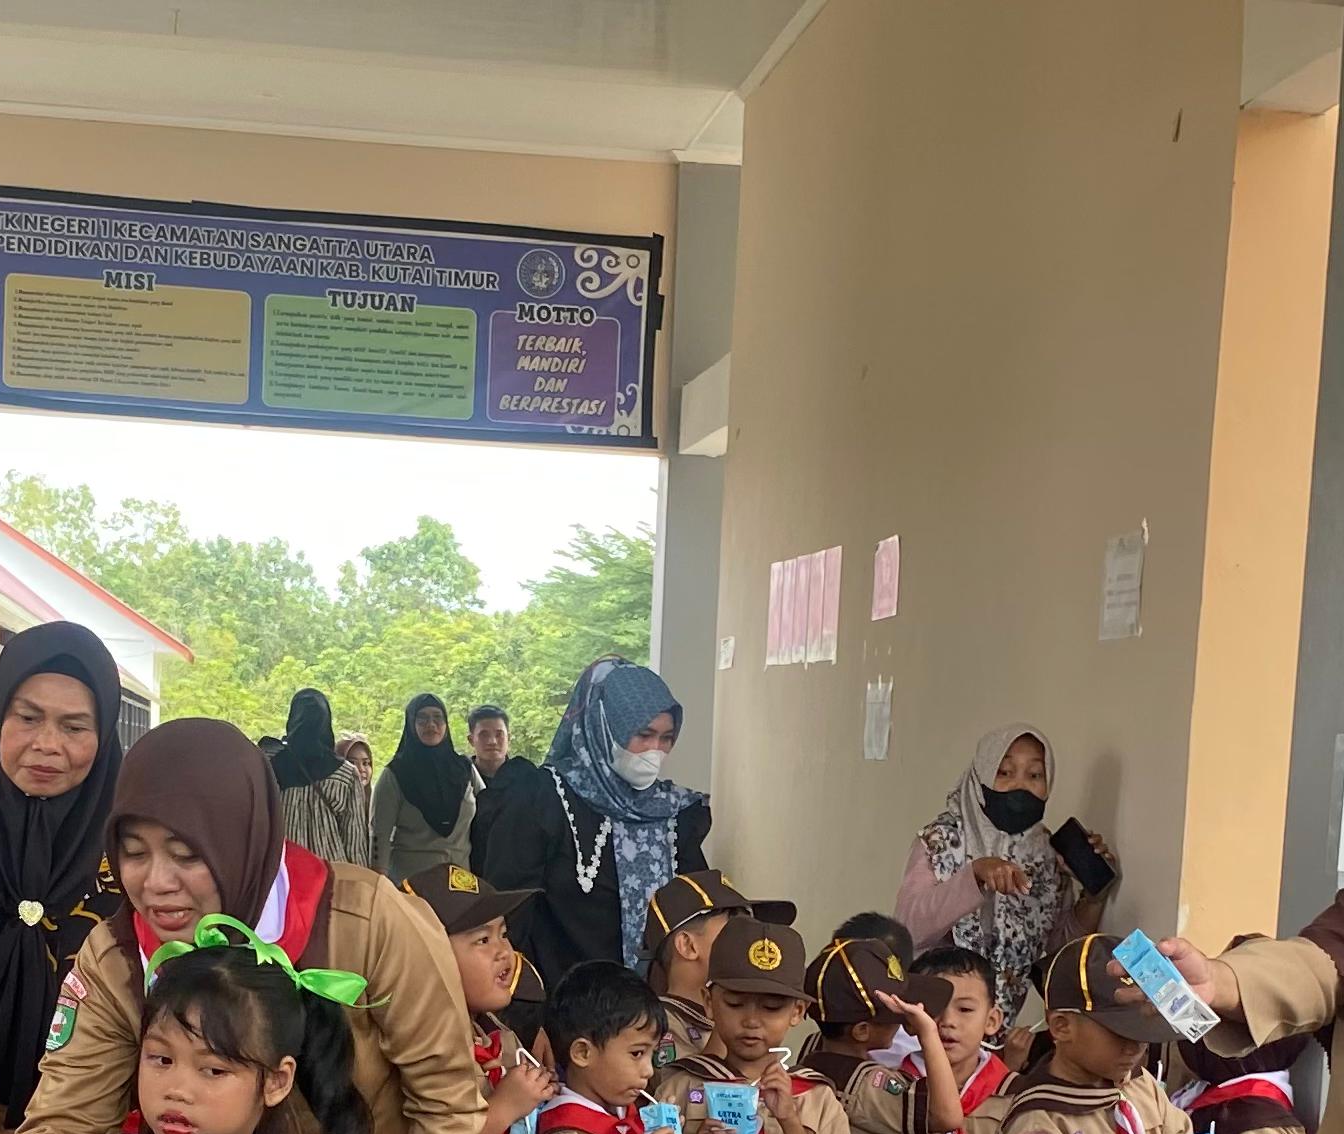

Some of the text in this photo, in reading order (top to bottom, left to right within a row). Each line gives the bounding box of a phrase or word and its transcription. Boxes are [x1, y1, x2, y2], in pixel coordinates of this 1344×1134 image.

[24, 214, 96, 236] NEGERI
[100, 218, 108, 237] 1
[113, 221, 245, 249] KECAMATAN
[250, 232, 361, 258] SANGATTA
[365, 241, 434, 263] UTARA
[124, 245, 168, 266] DAN
[173, 249, 313, 276] KEBUDAYAAN
[319, 260, 366, 281] KAB.
[371, 265, 431, 286] KUTAI
[436, 269, 499, 290] TIMUR
[103, 270, 156, 292] MISI
[327, 289, 417, 313] TUJUAN
[516, 303, 596, 326] MOTTO
[517, 335, 587, 355] TERBAIK,
[516, 355, 587, 374] MANDIRI
[533, 376, 568, 393] DAN
[498, 395, 606, 416] BERPRESTASI
